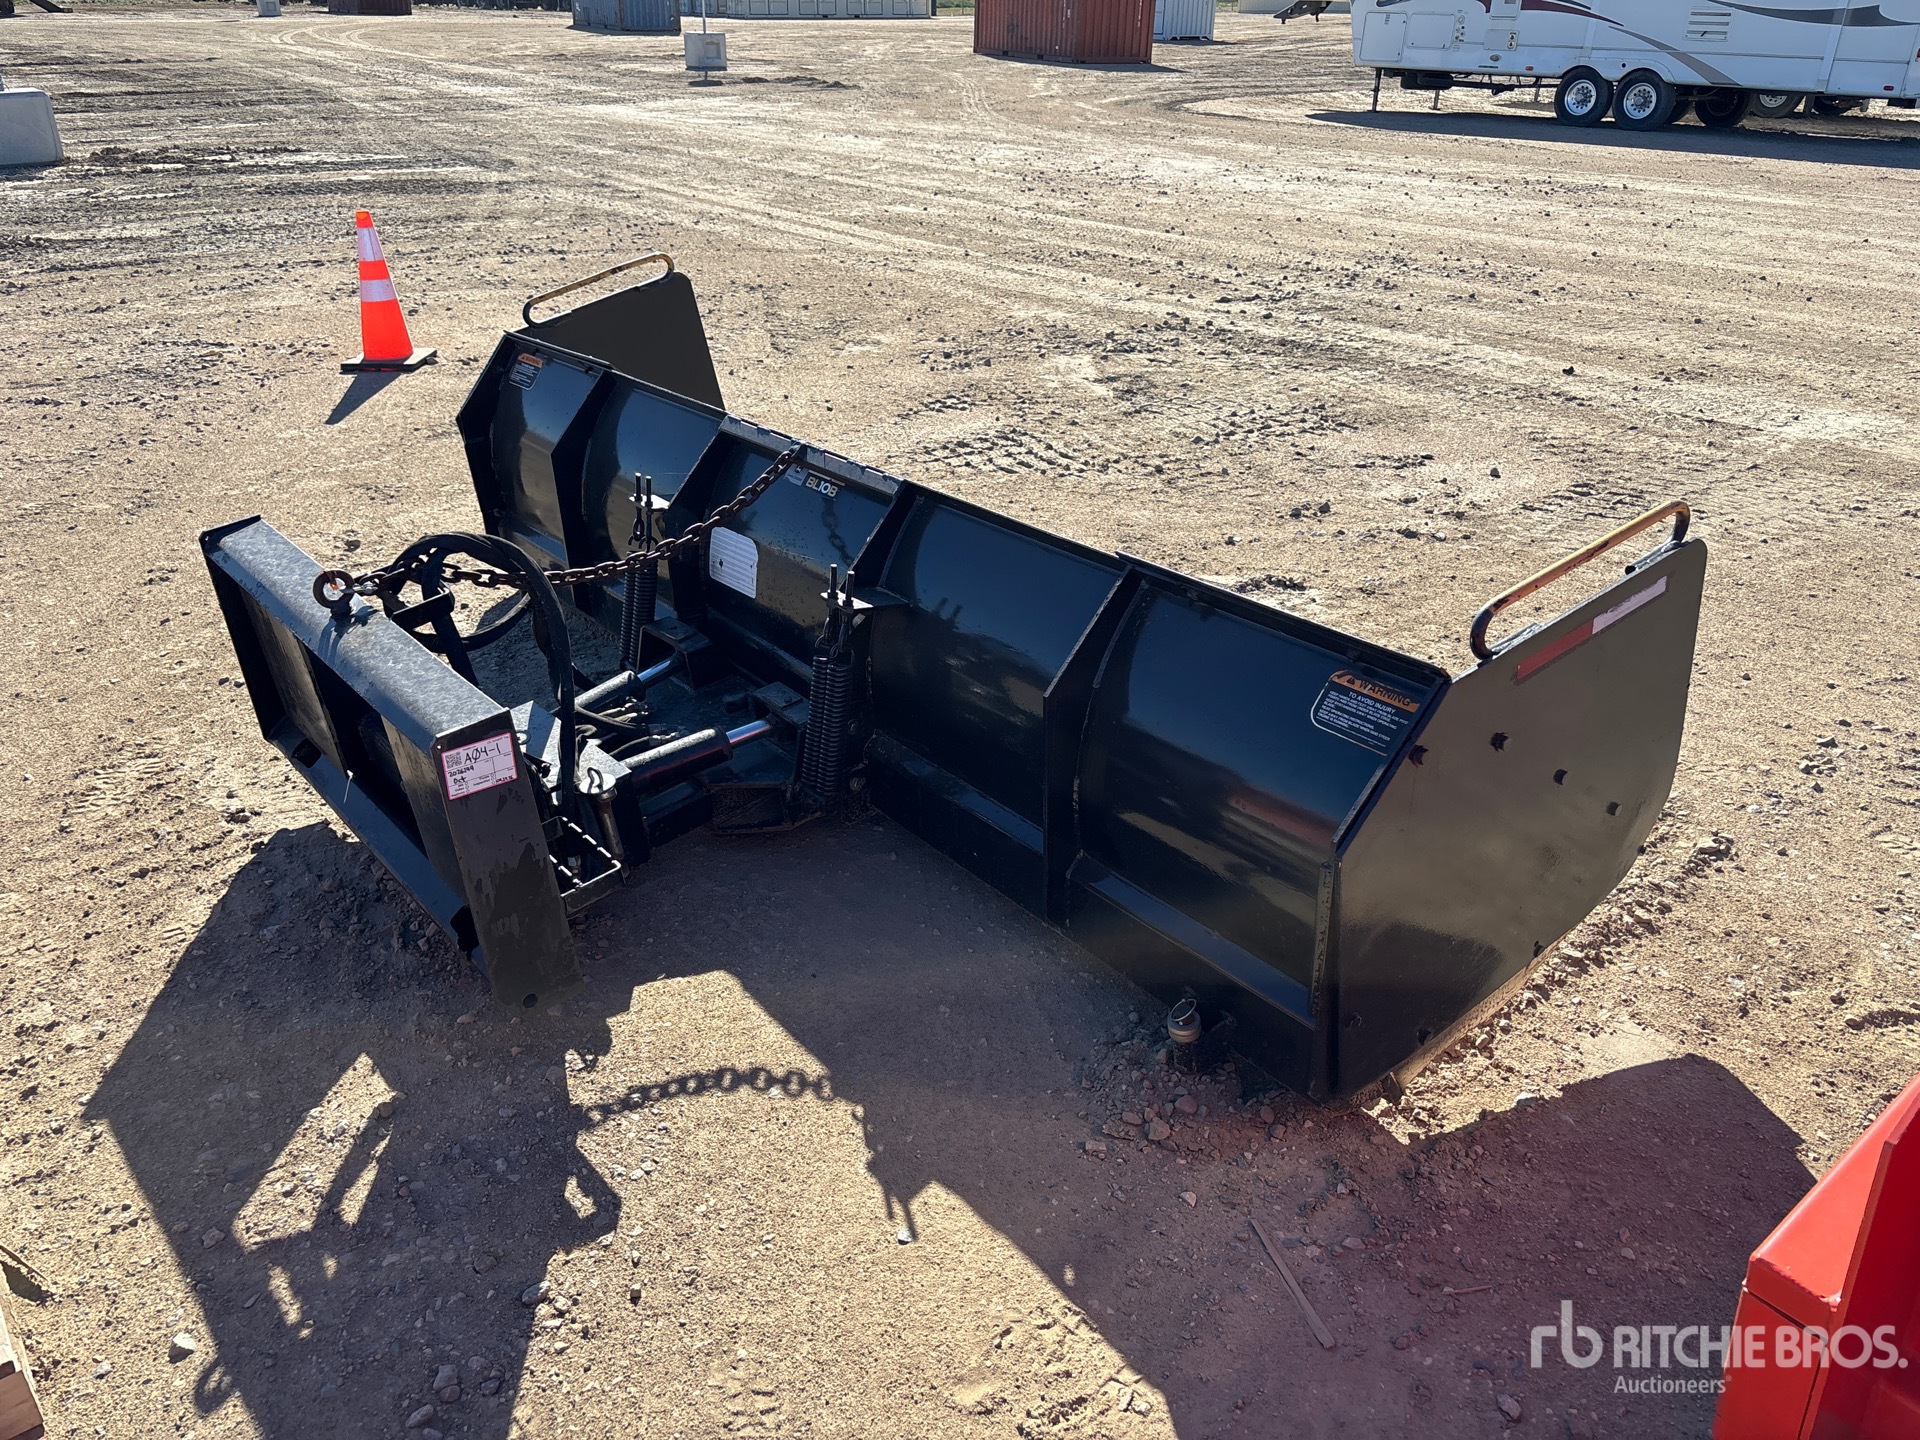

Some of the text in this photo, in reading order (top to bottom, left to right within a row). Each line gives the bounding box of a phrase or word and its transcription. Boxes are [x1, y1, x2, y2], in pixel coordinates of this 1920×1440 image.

[1356, 694, 1375, 706] AVOID
[1373, 702, 1396, 714] INJURY
[1359, 680, 1412, 706] WARNING
